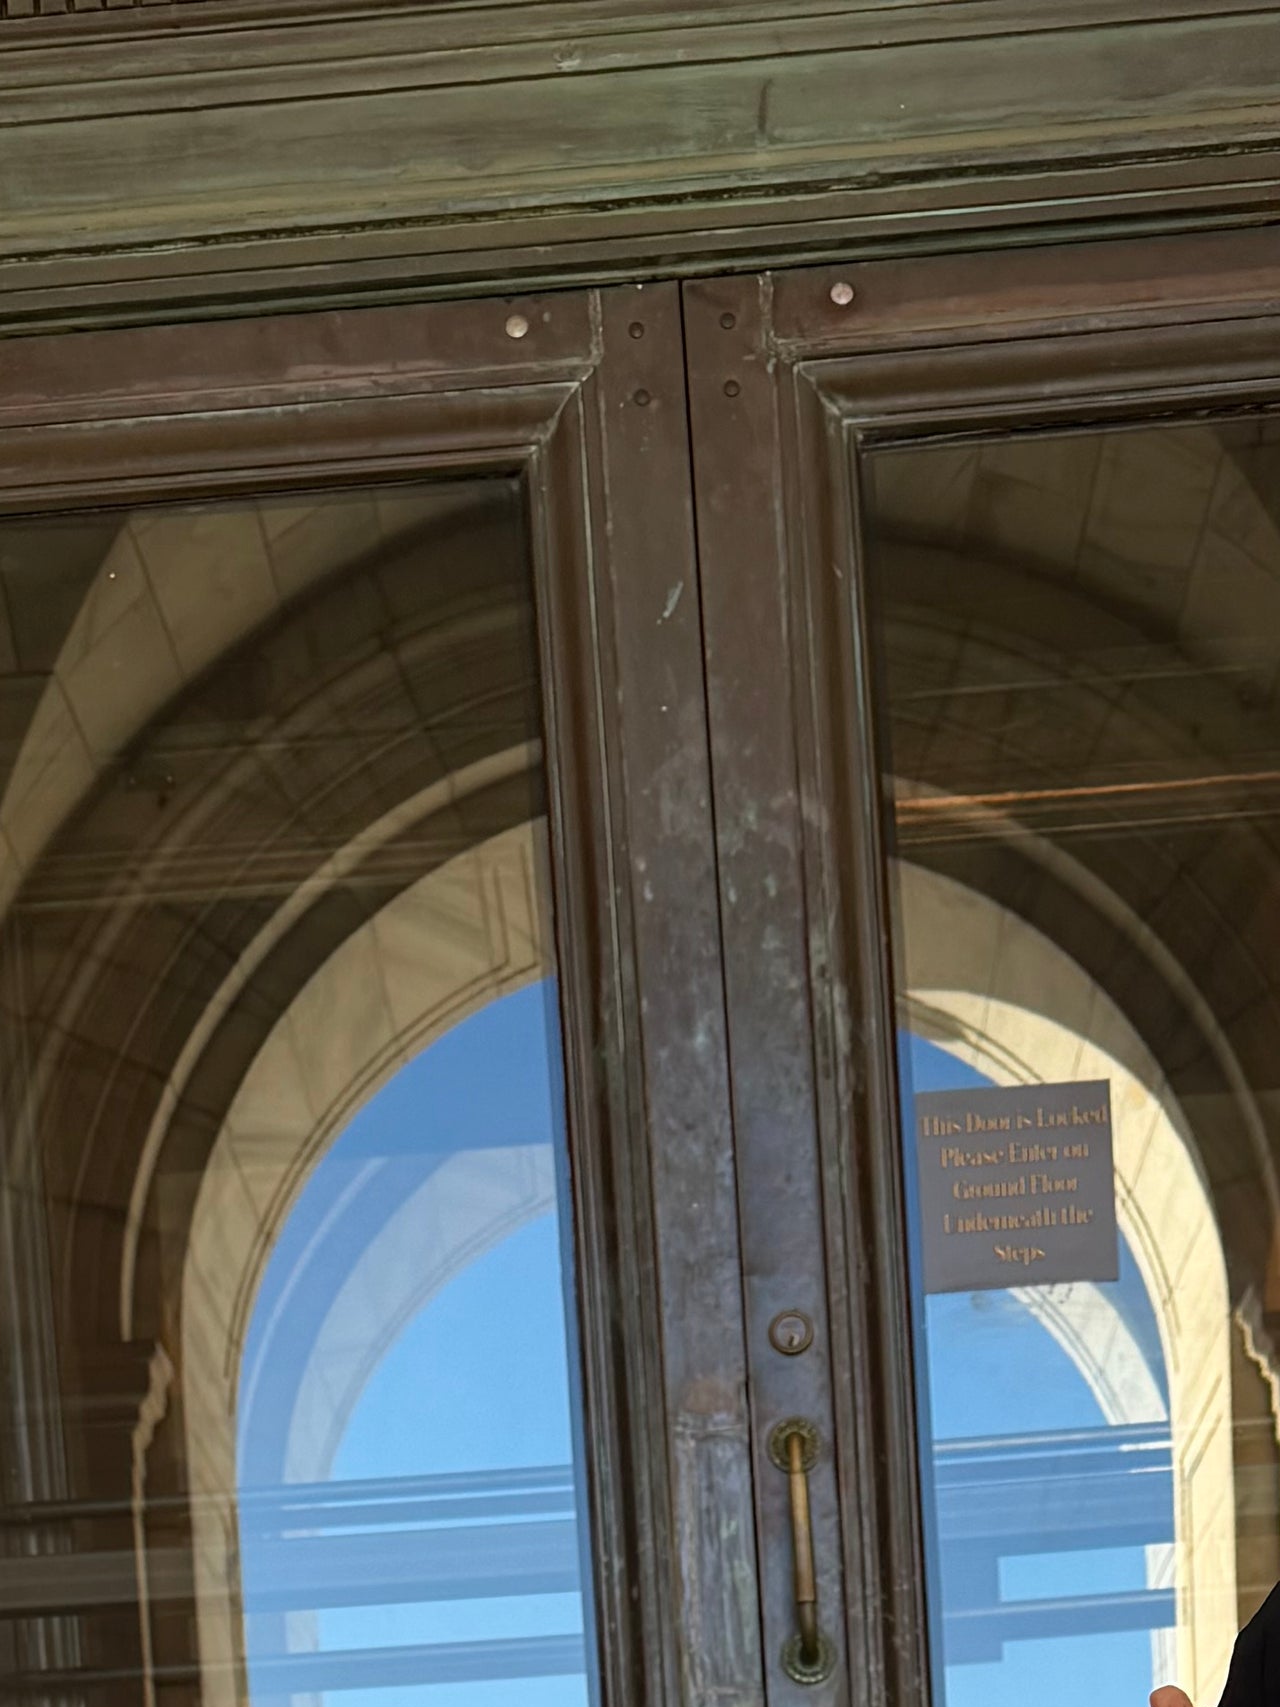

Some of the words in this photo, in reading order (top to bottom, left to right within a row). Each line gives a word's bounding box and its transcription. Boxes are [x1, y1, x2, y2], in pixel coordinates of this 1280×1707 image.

[922, 1115, 961, 1136] This
[966, 1112, 1010, 1133] Door
[1016, 1110, 1032, 1129] is
[1036, 1104, 1107, 1128] Locked
[940, 1145, 1005, 1168] Please
[1008, 1141, 1058, 1163] Enter
[1063, 1143, 1089, 1159] on
[952, 1177, 1026, 1199] Ground
[1030, 1173, 1078, 1195] Floor
[944, 1208, 1056, 1233] Underneath
[1060, 1204, 1094, 1225] the
[993, 1244, 1046, 1266] Steps
